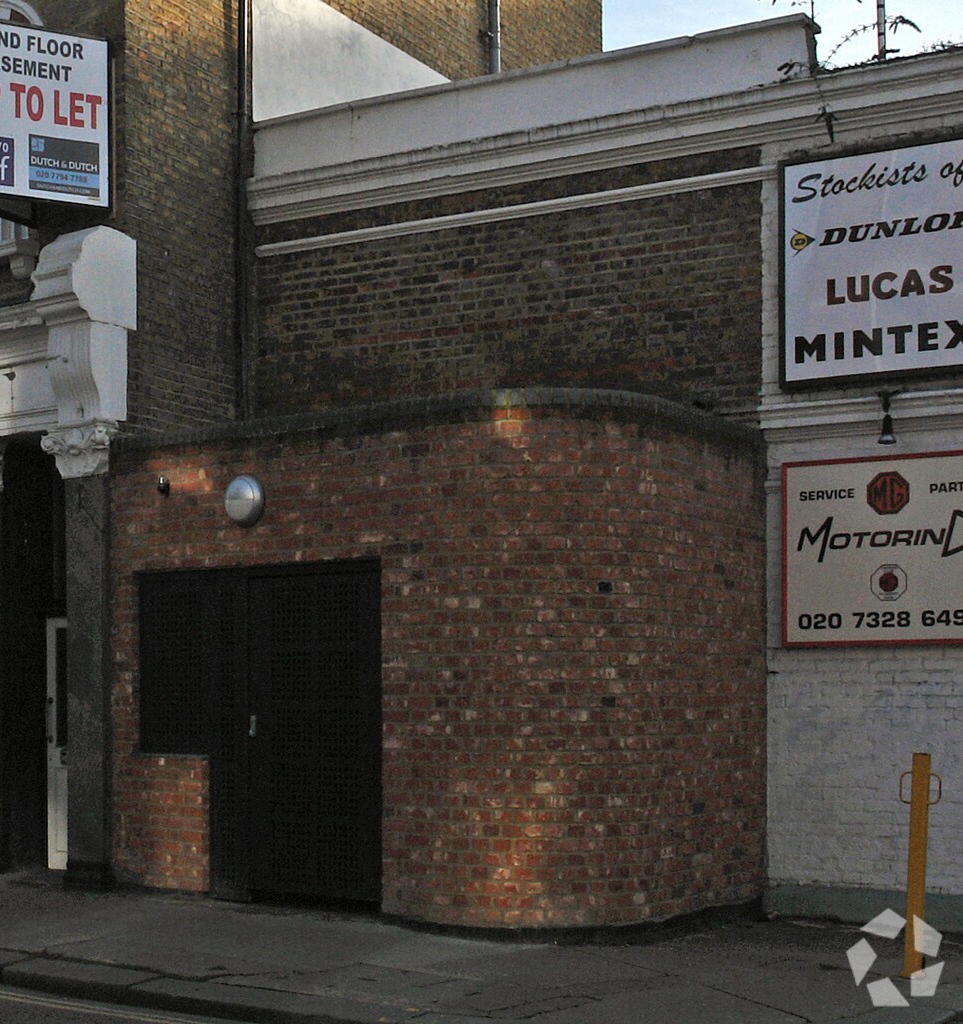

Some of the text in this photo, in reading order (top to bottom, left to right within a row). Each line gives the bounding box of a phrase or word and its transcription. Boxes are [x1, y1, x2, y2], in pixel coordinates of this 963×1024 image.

[26, 35, 84, 60] FLOOR
[9, 82, 44, 122] TO
[53, 89, 102, 129] LET
[30, 155, 98, 172] DUTCH & DUTCH
[792, 162, 928, 204] Stockists
[826, 264, 954, 306] LUCAS
[794, 319, 963, 364] MINTEX
[799, 487, 855, 502] SERVICE
[872, 477, 905, 511] MG
[798, 613, 842, 629] 020
[852, 611, 911, 628] 7328
